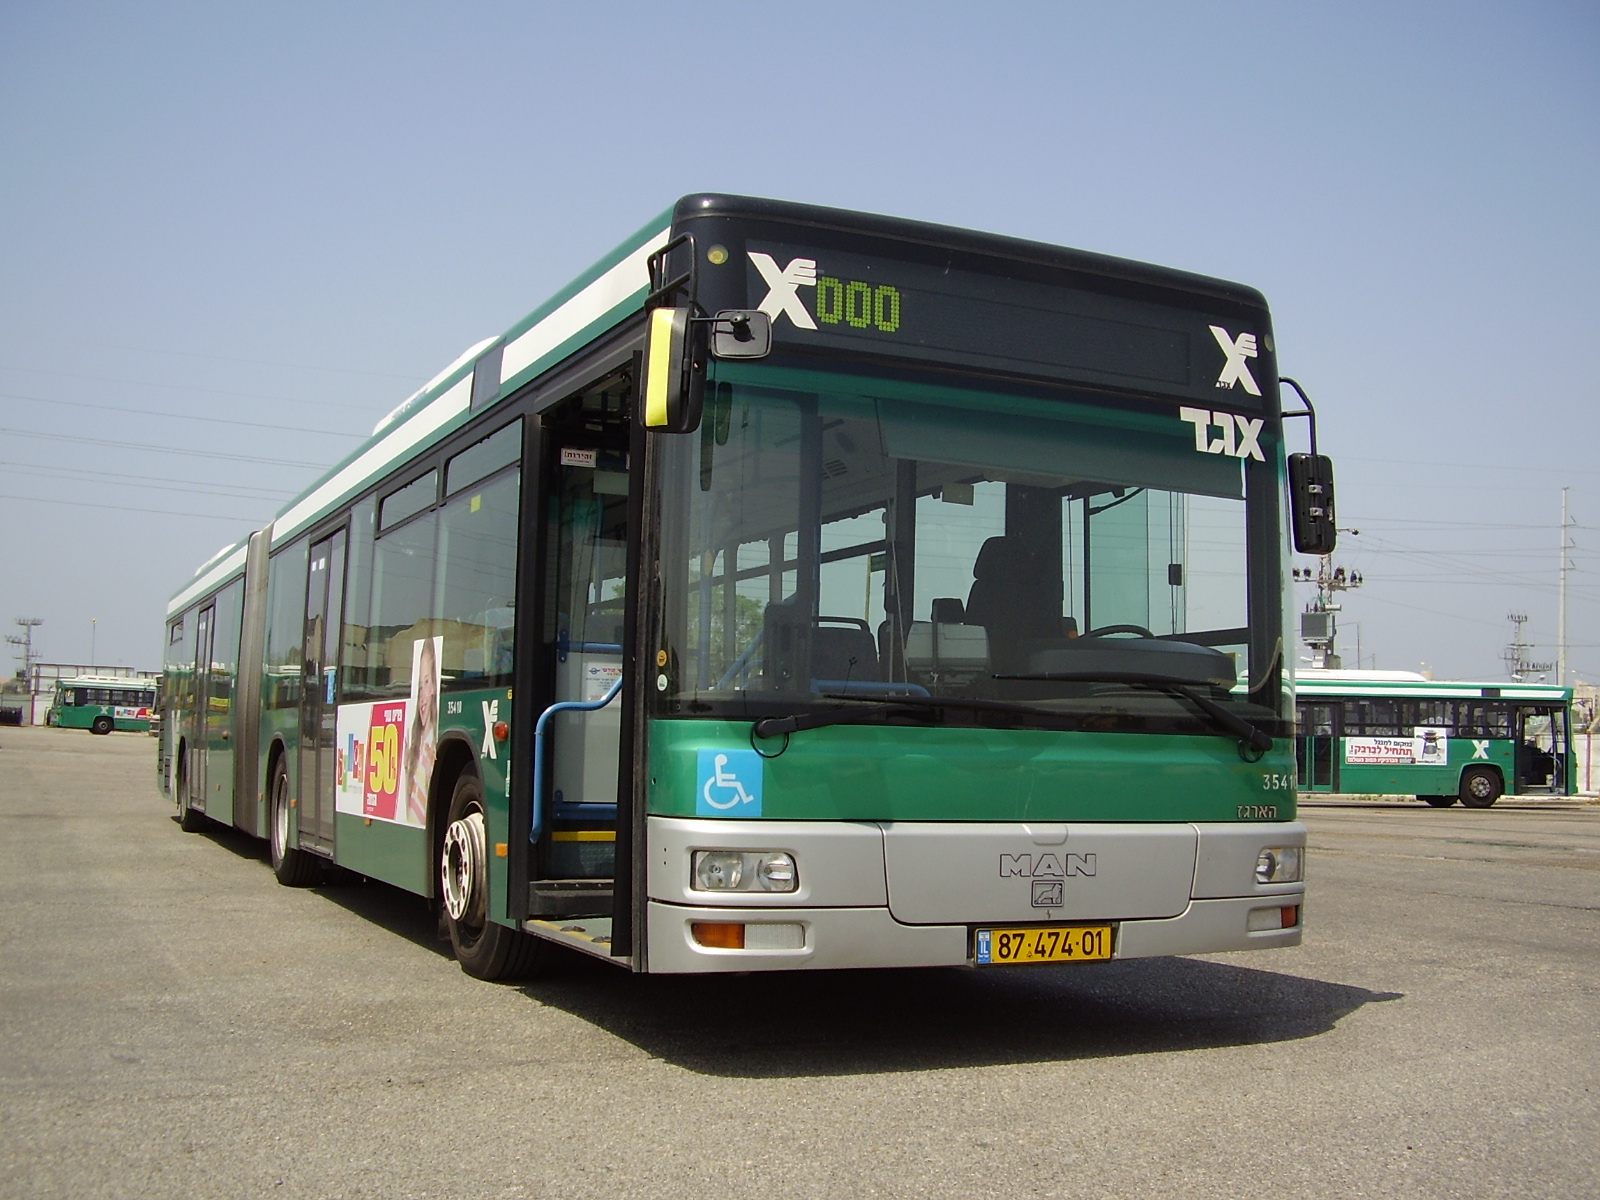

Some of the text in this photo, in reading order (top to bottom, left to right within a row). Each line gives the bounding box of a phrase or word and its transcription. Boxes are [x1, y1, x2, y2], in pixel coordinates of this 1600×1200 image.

[817, 276, 900, 333] 000
[1179, 405, 1267, 463] אגד
[1236, 804, 1277, 819] הארגז
[999, 852, 1097, 878] MAN
